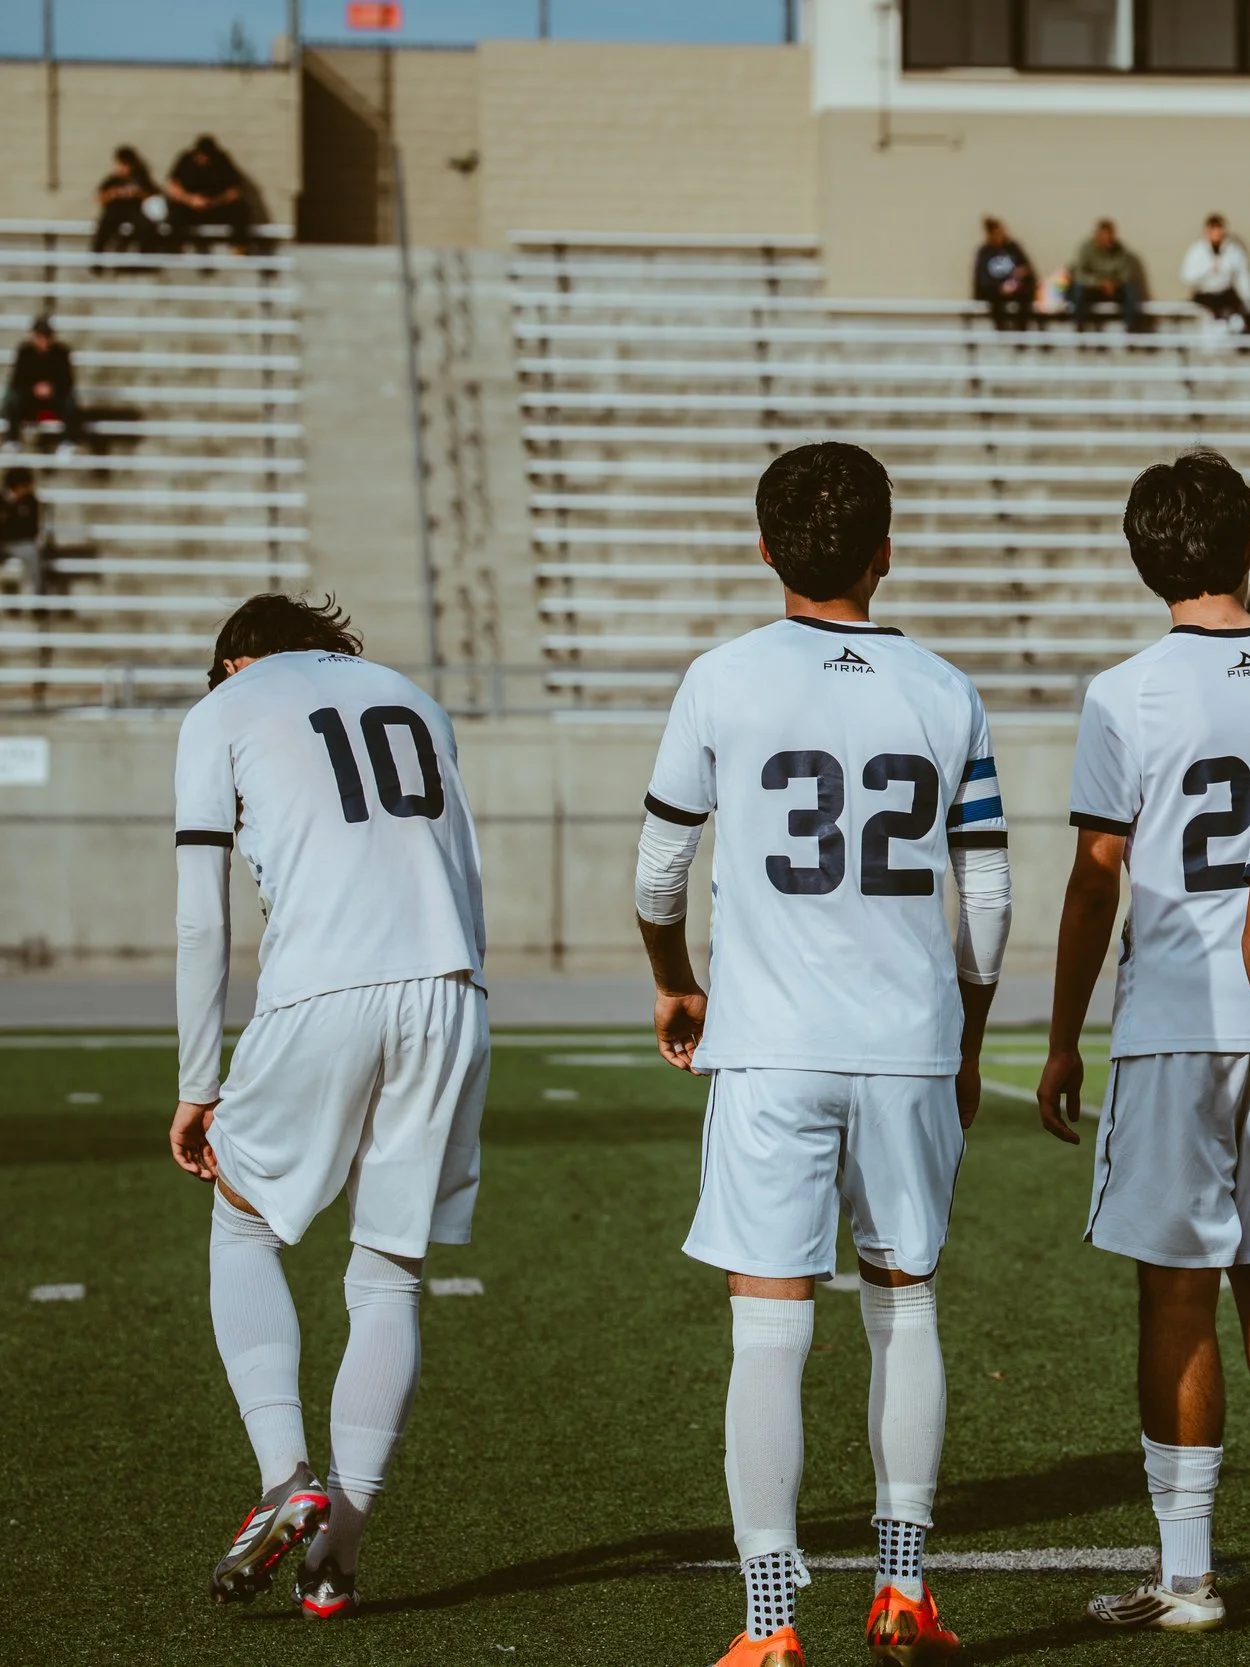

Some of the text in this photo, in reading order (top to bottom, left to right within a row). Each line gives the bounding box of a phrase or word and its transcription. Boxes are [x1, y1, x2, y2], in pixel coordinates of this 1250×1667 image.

[823, 662, 875, 673] PIRMA
[308, 705, 444, 823] 10
[761, 750, 939, 896] 32
